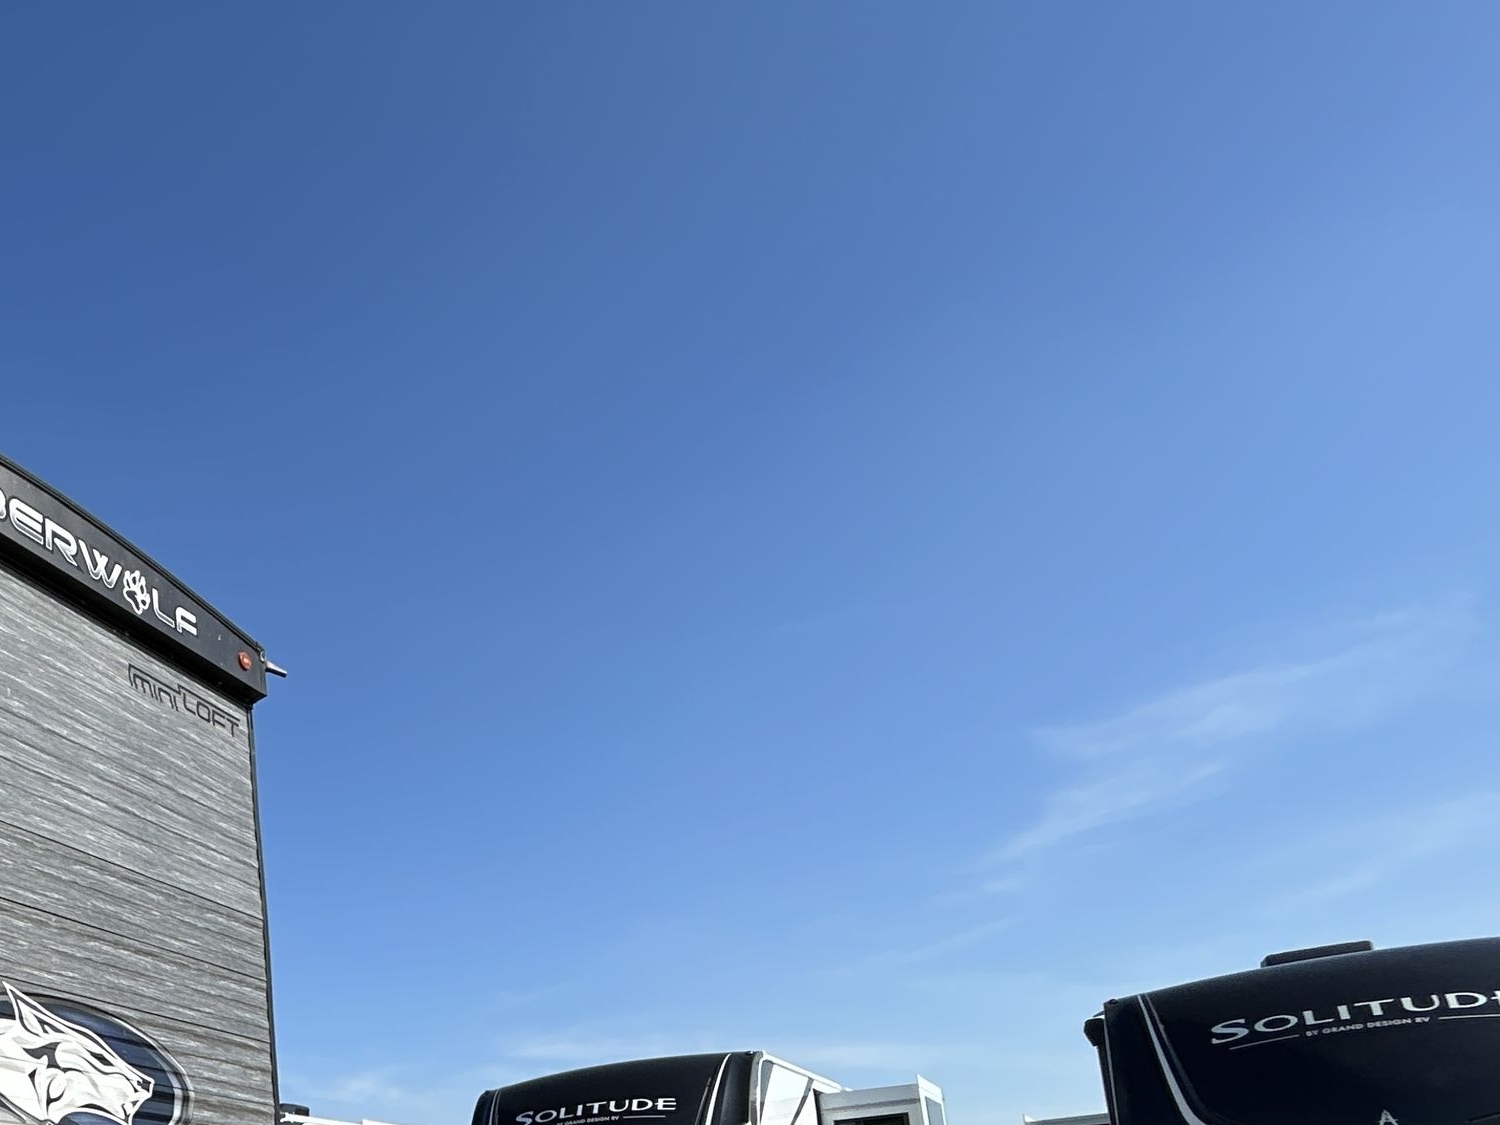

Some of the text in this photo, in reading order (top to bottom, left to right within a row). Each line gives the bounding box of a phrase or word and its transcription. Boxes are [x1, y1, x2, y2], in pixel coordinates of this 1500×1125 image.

[182, 689, 240, 738] LOFT
[1211, 989, 1500, 1045] SOLITUD
[1305, 1015, 1431, 1037] BY GRAND DESIGN RV
[586, 1115, 610, 1123] DESIGN
